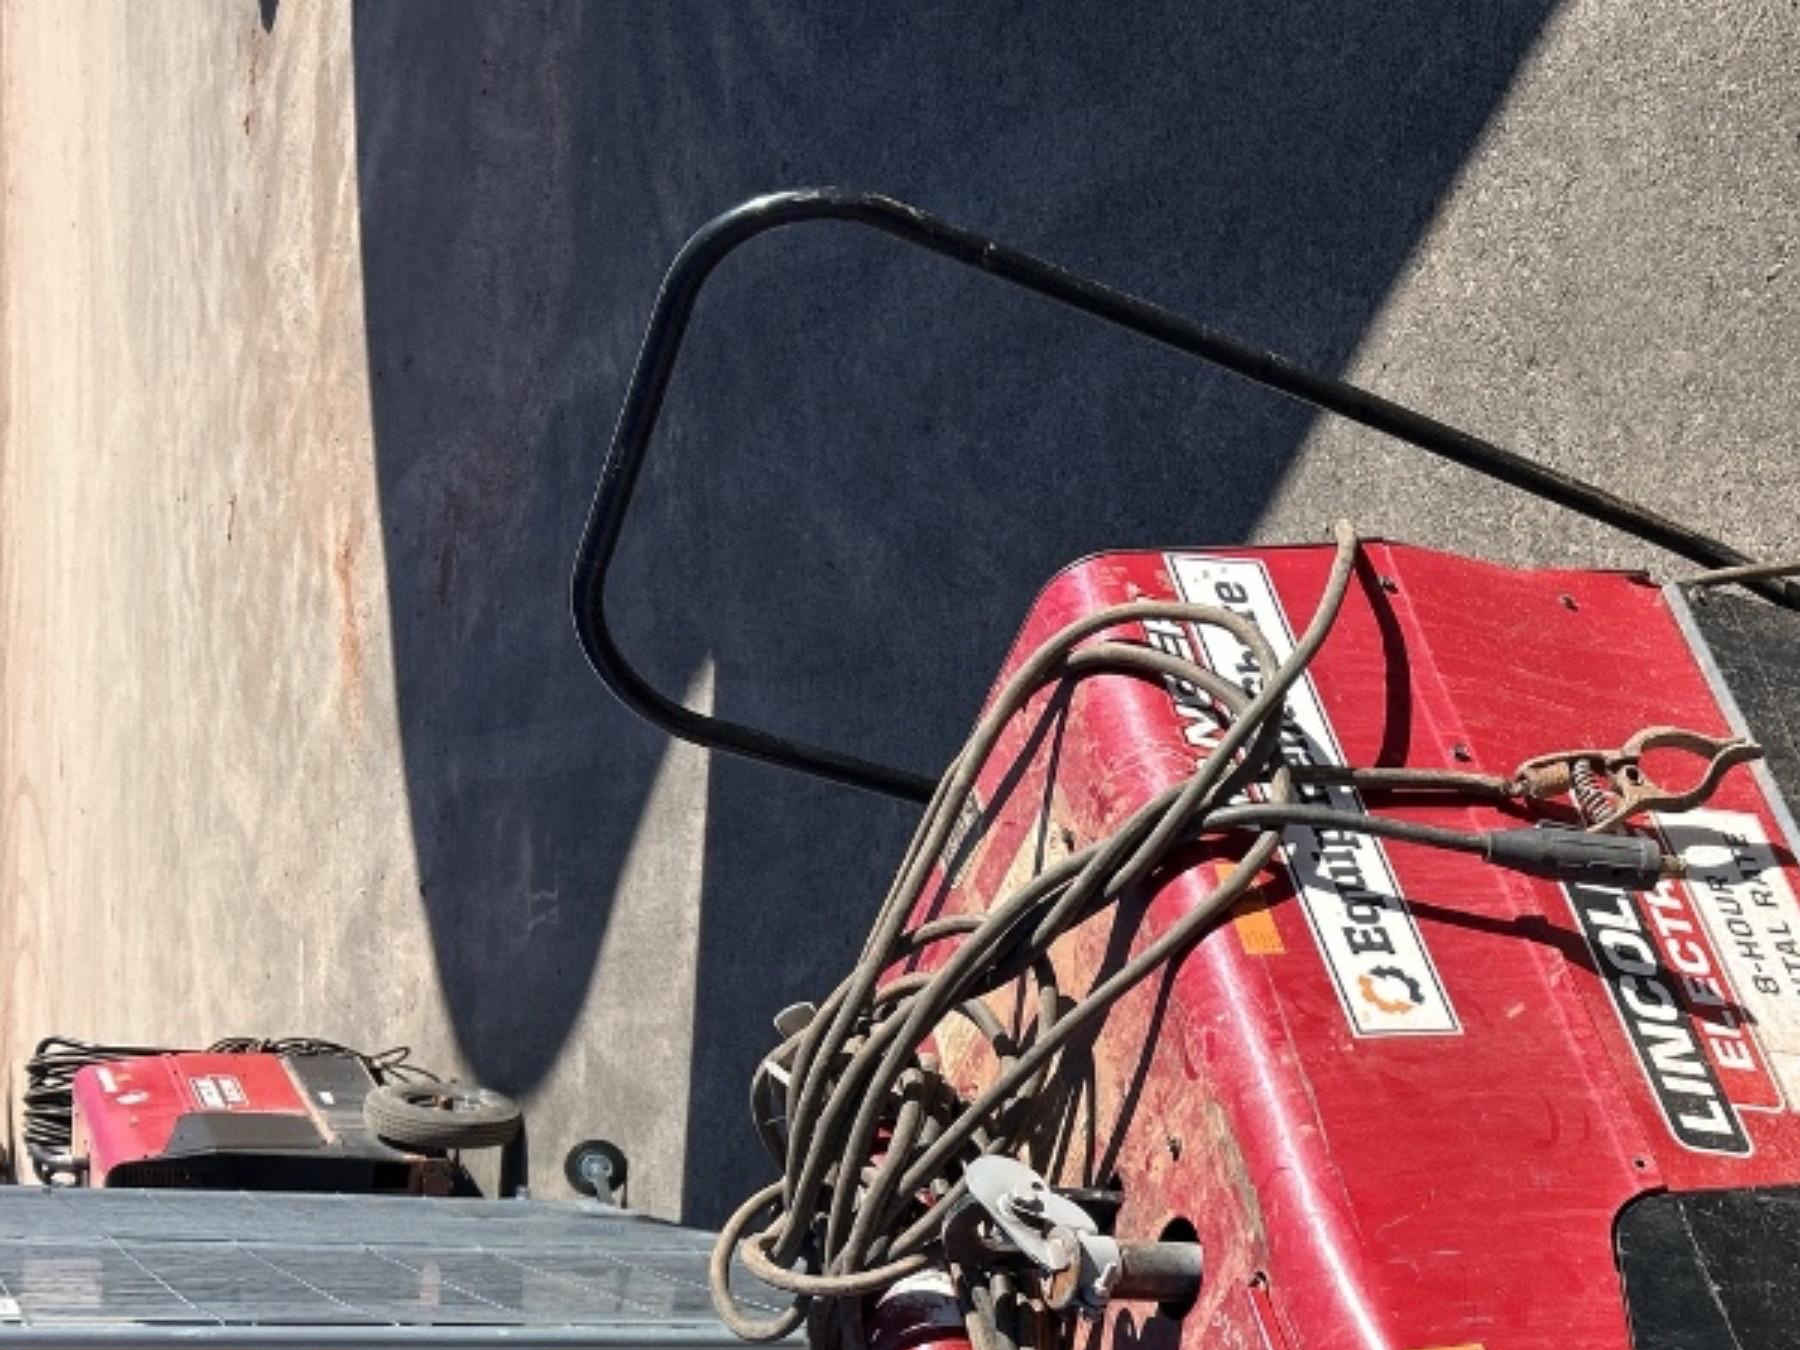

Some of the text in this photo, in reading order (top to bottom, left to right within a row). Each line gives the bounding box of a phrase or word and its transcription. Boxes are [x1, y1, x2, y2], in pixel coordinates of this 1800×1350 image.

[1725, 830, 1778, 909] RATE
[1705, 874, 1780, 997] 8-HOUR
[1575, 882, 1733, 1136] LINCOL
